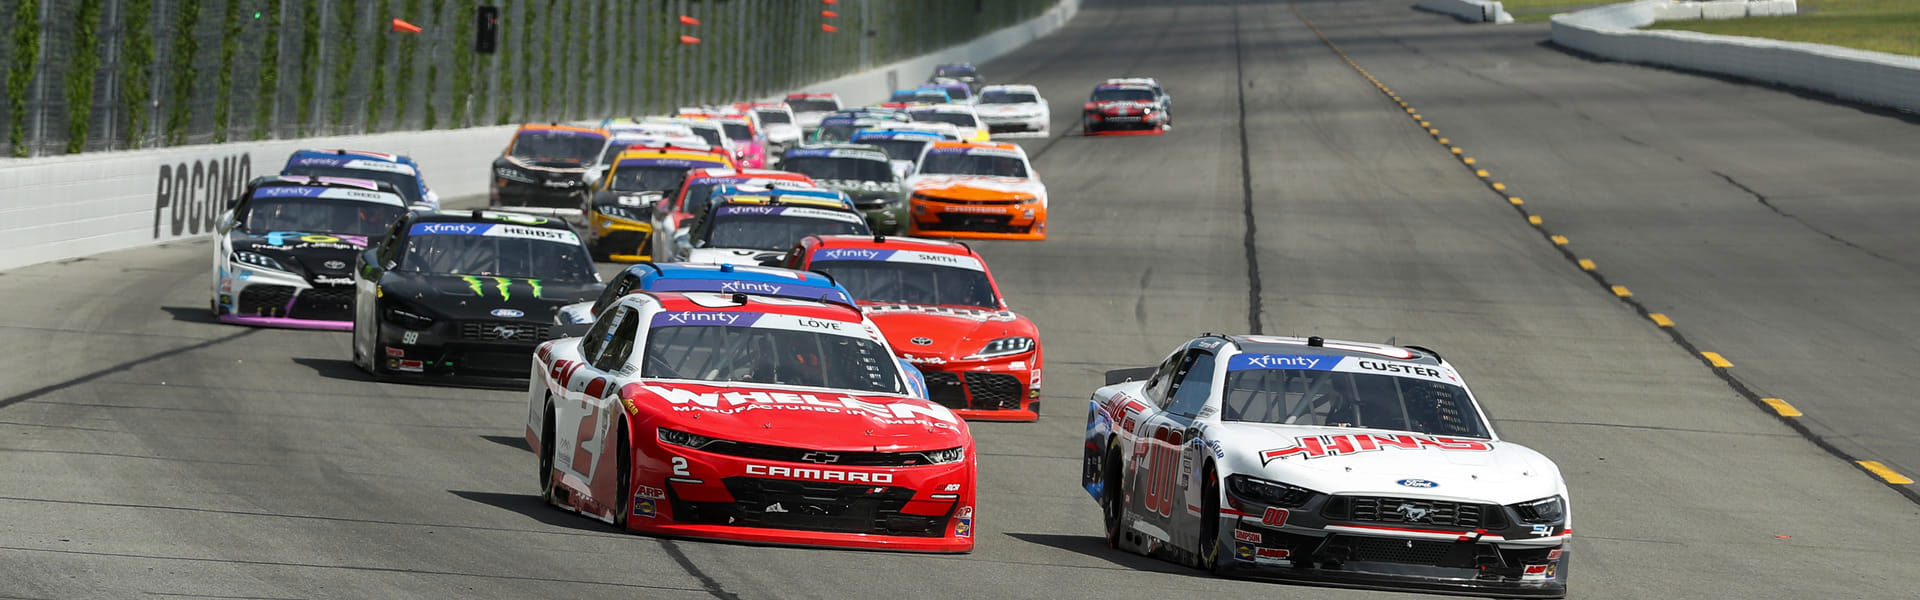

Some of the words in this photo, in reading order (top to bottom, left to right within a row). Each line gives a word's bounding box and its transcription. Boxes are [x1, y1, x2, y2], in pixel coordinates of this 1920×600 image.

[266, 186, 313, 197] xfinity
[346, 191, 381, 199] CREED
[728, 206, 774, 215] xfinity
[423, 223, 477, 235] xfinity
[503, 226, 564, 239] HERBST
[825, 248, 879, 260] xfinity
[918, 253, 957, 264] SMITH
[722, 280, 782, 294] xfinity
[668, 310, 740, 324] xfinity
[798, 318, 842, 331] LOVE
[402, 330, 419, 345] 98
[1247, 355, 1321, 369] xfinity
[1358, 360, 1441, 379] CUSTER
[641, 385, 959, 425] WHELEN
[672, 404, 841, 415] MANUFACTURED
[846, 408, 867, 416] IN
[872, 416, 961, 434] AMERICA
[671, 456, 690, 477] 2
[745, 463, 893, 483] CAMARO
[1145, 425, 1183, 518] 00
[640, 485, 663, 498] ARP
[1262, 507, 1289, 527] 00
